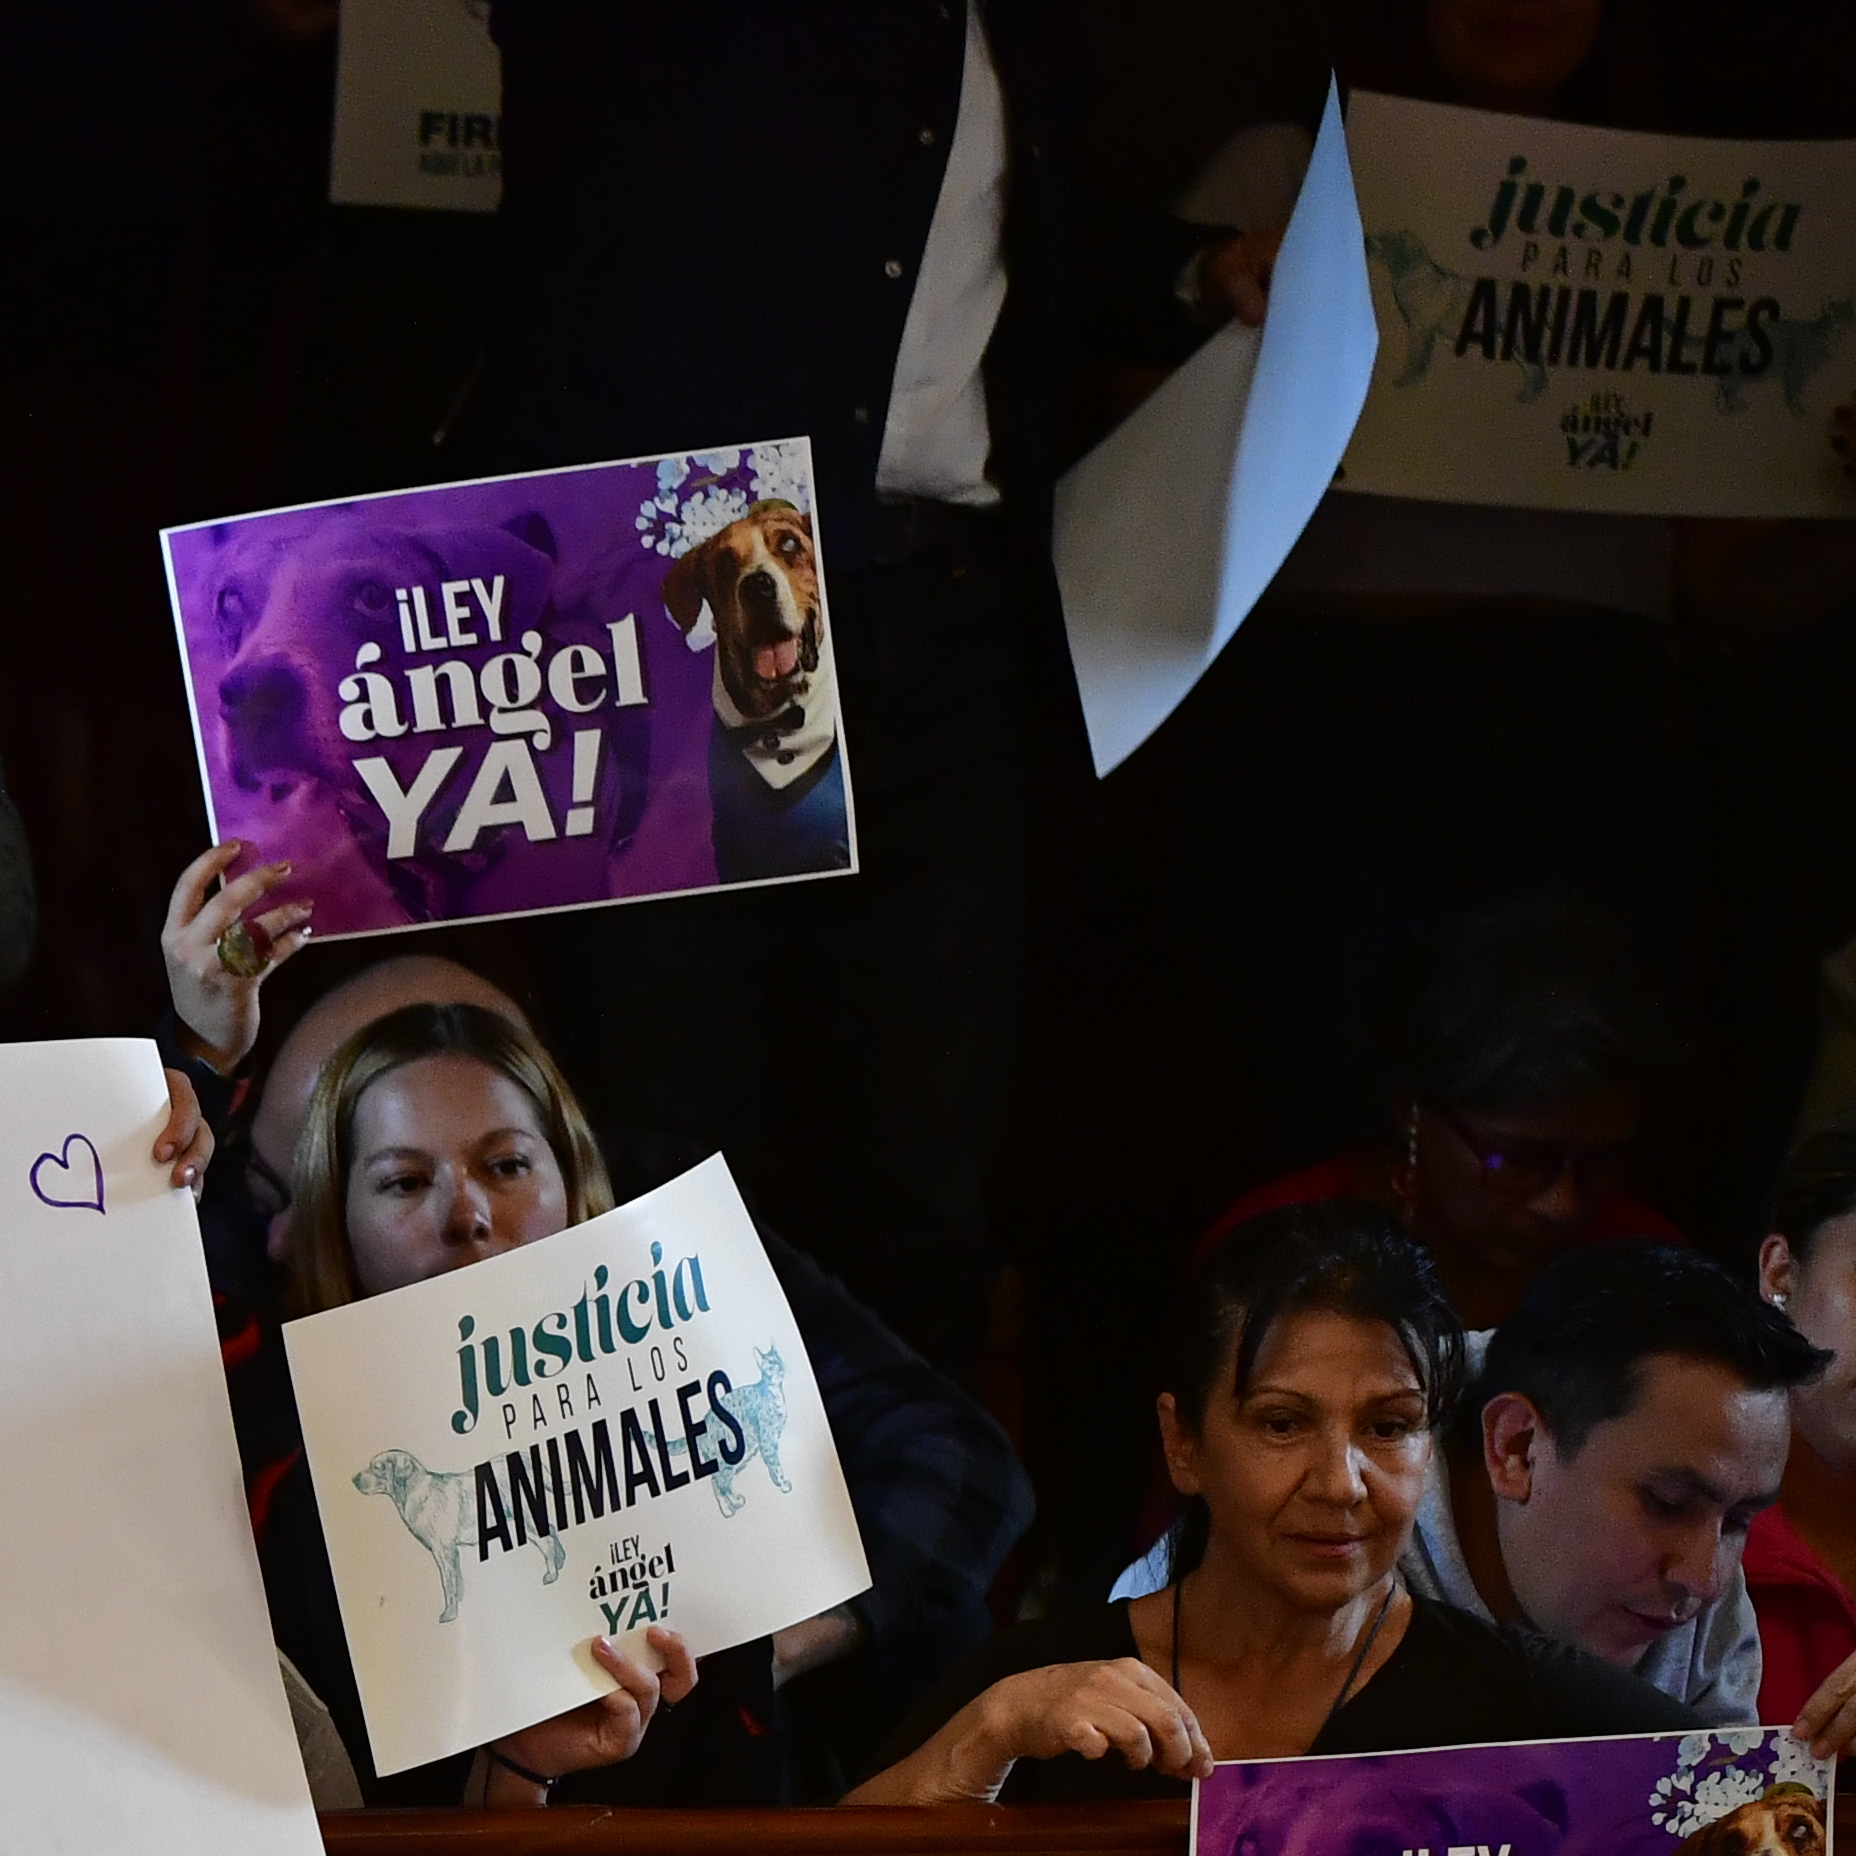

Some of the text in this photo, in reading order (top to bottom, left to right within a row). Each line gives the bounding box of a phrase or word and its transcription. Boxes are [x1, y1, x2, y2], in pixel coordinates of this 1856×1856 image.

[1470, 155, 1802, 252] justicia
[1520, 241, 1746, 290] PARA LOS
[1454, 277, 1781, 377] ANIMALES
[338, 612, 649, 752] ángel
[352, 729, 602, 860] YA!
[451, 1241, 711, 1435] justicia
[503, 1336, 690, 1440] PARA LOS
[472, 1369, 747, 1563] ANIMALES
[588, 1541, 676, 1601] ángel
[598, 1580, 671, 1637] YA!
